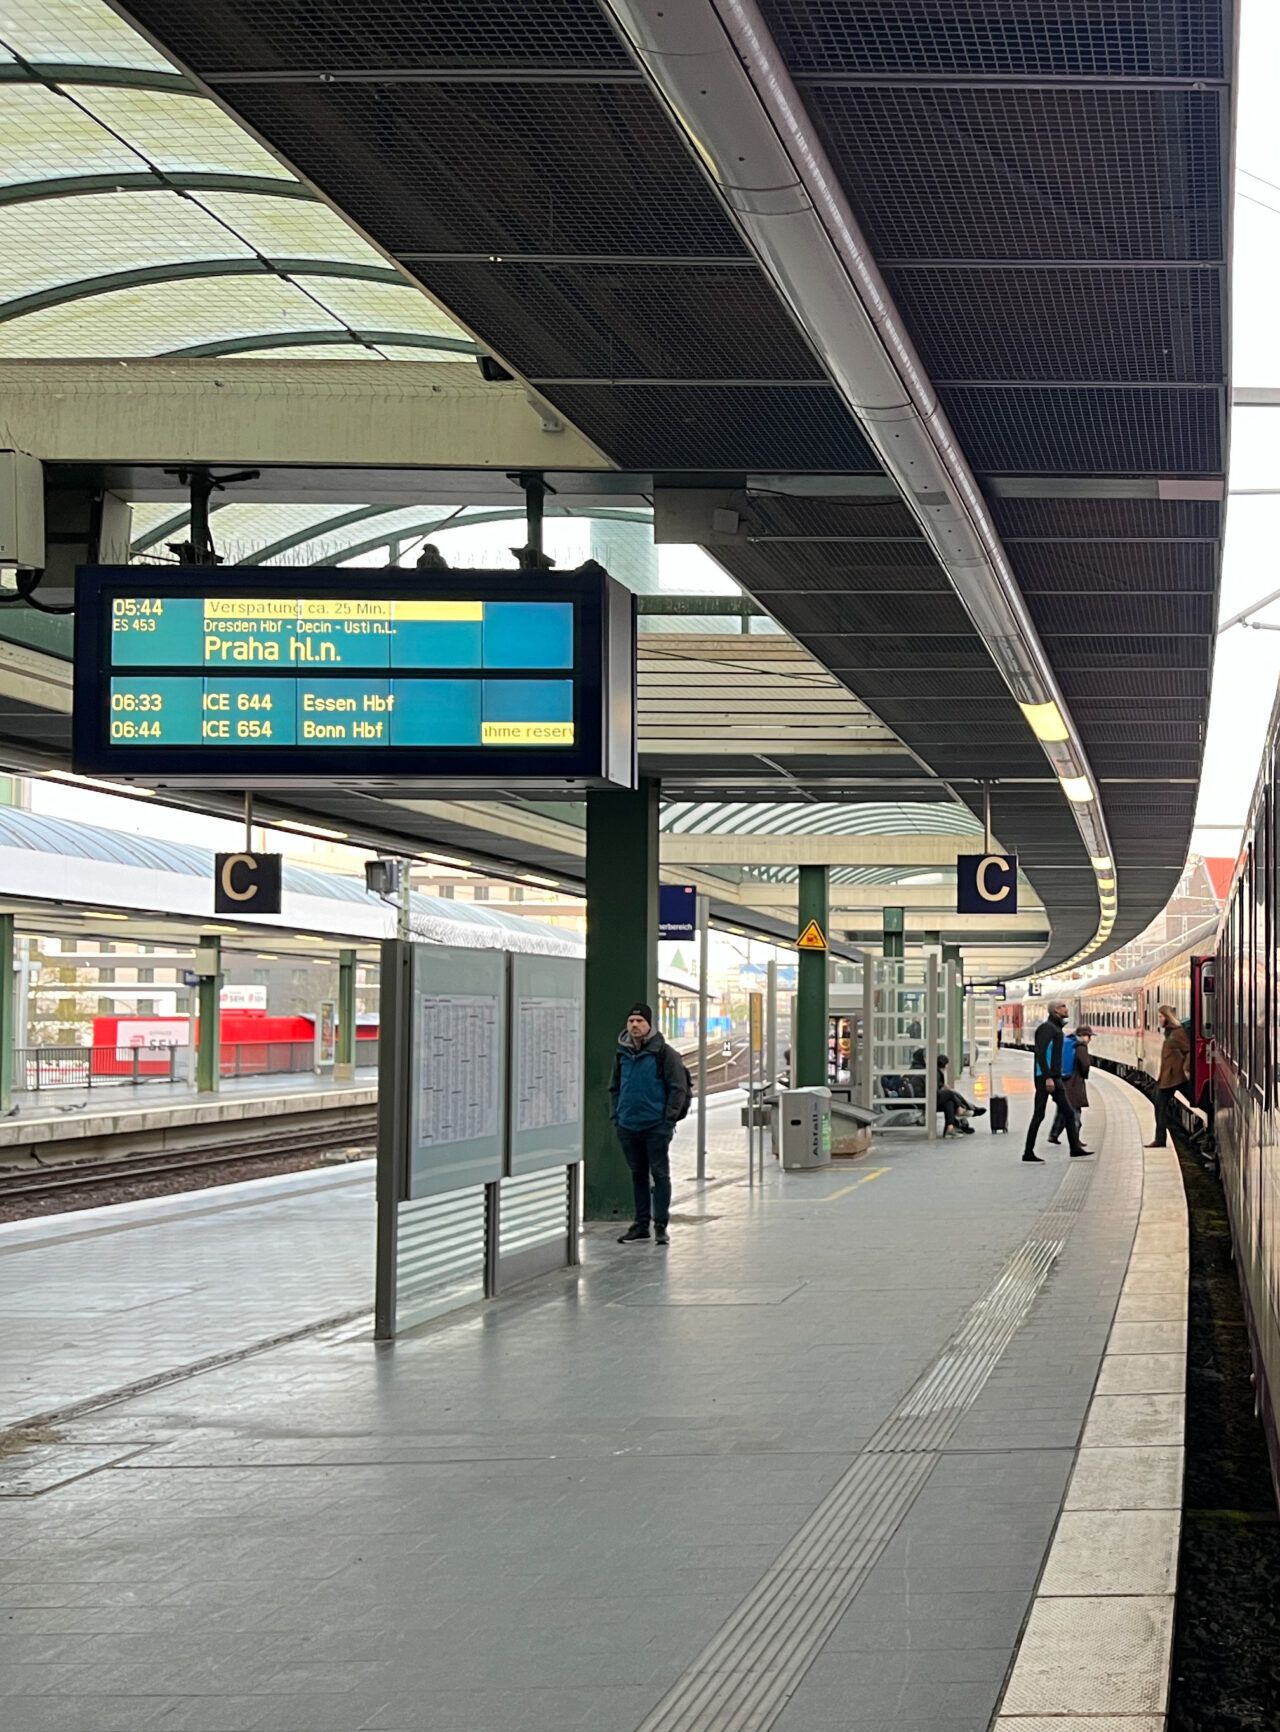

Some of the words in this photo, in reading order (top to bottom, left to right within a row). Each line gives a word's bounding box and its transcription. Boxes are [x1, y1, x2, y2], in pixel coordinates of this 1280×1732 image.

[113, 599, 163, 616] 05:44
[308, 603, 329, 615] ca.
[335, 603, 350, 614] 25
[357, 604, 386, 615] Min.
[113, 619, 129, 631] ES
[132, 619, 156, 631] 453
[203, 619, 257, 632] Dresden
[260, 620, 282, 632] Hbf
[297, 620, 332, 633] Decin
[205, 635, 279, 660] Praha
[290, 636, 342, 662] hl.n.
[112, 694, 162, 711] 06:33
[203, 693, 230, 710] ICE
[237, 694, 272, 710] 644
[303, 693, 357, 711] Essen
[363, 694, 395, 711] Hbf
[112, 721, 162, 738] 06:44
[202, 720, 230, 737] ICE
[237, 720, 272, 737] 654
[303, 720, 346, 738] Bonn
[353, 721, 383, 738] Hbf
[222, 854, 258, 901] C
[976, 855, 1010, 902] C
